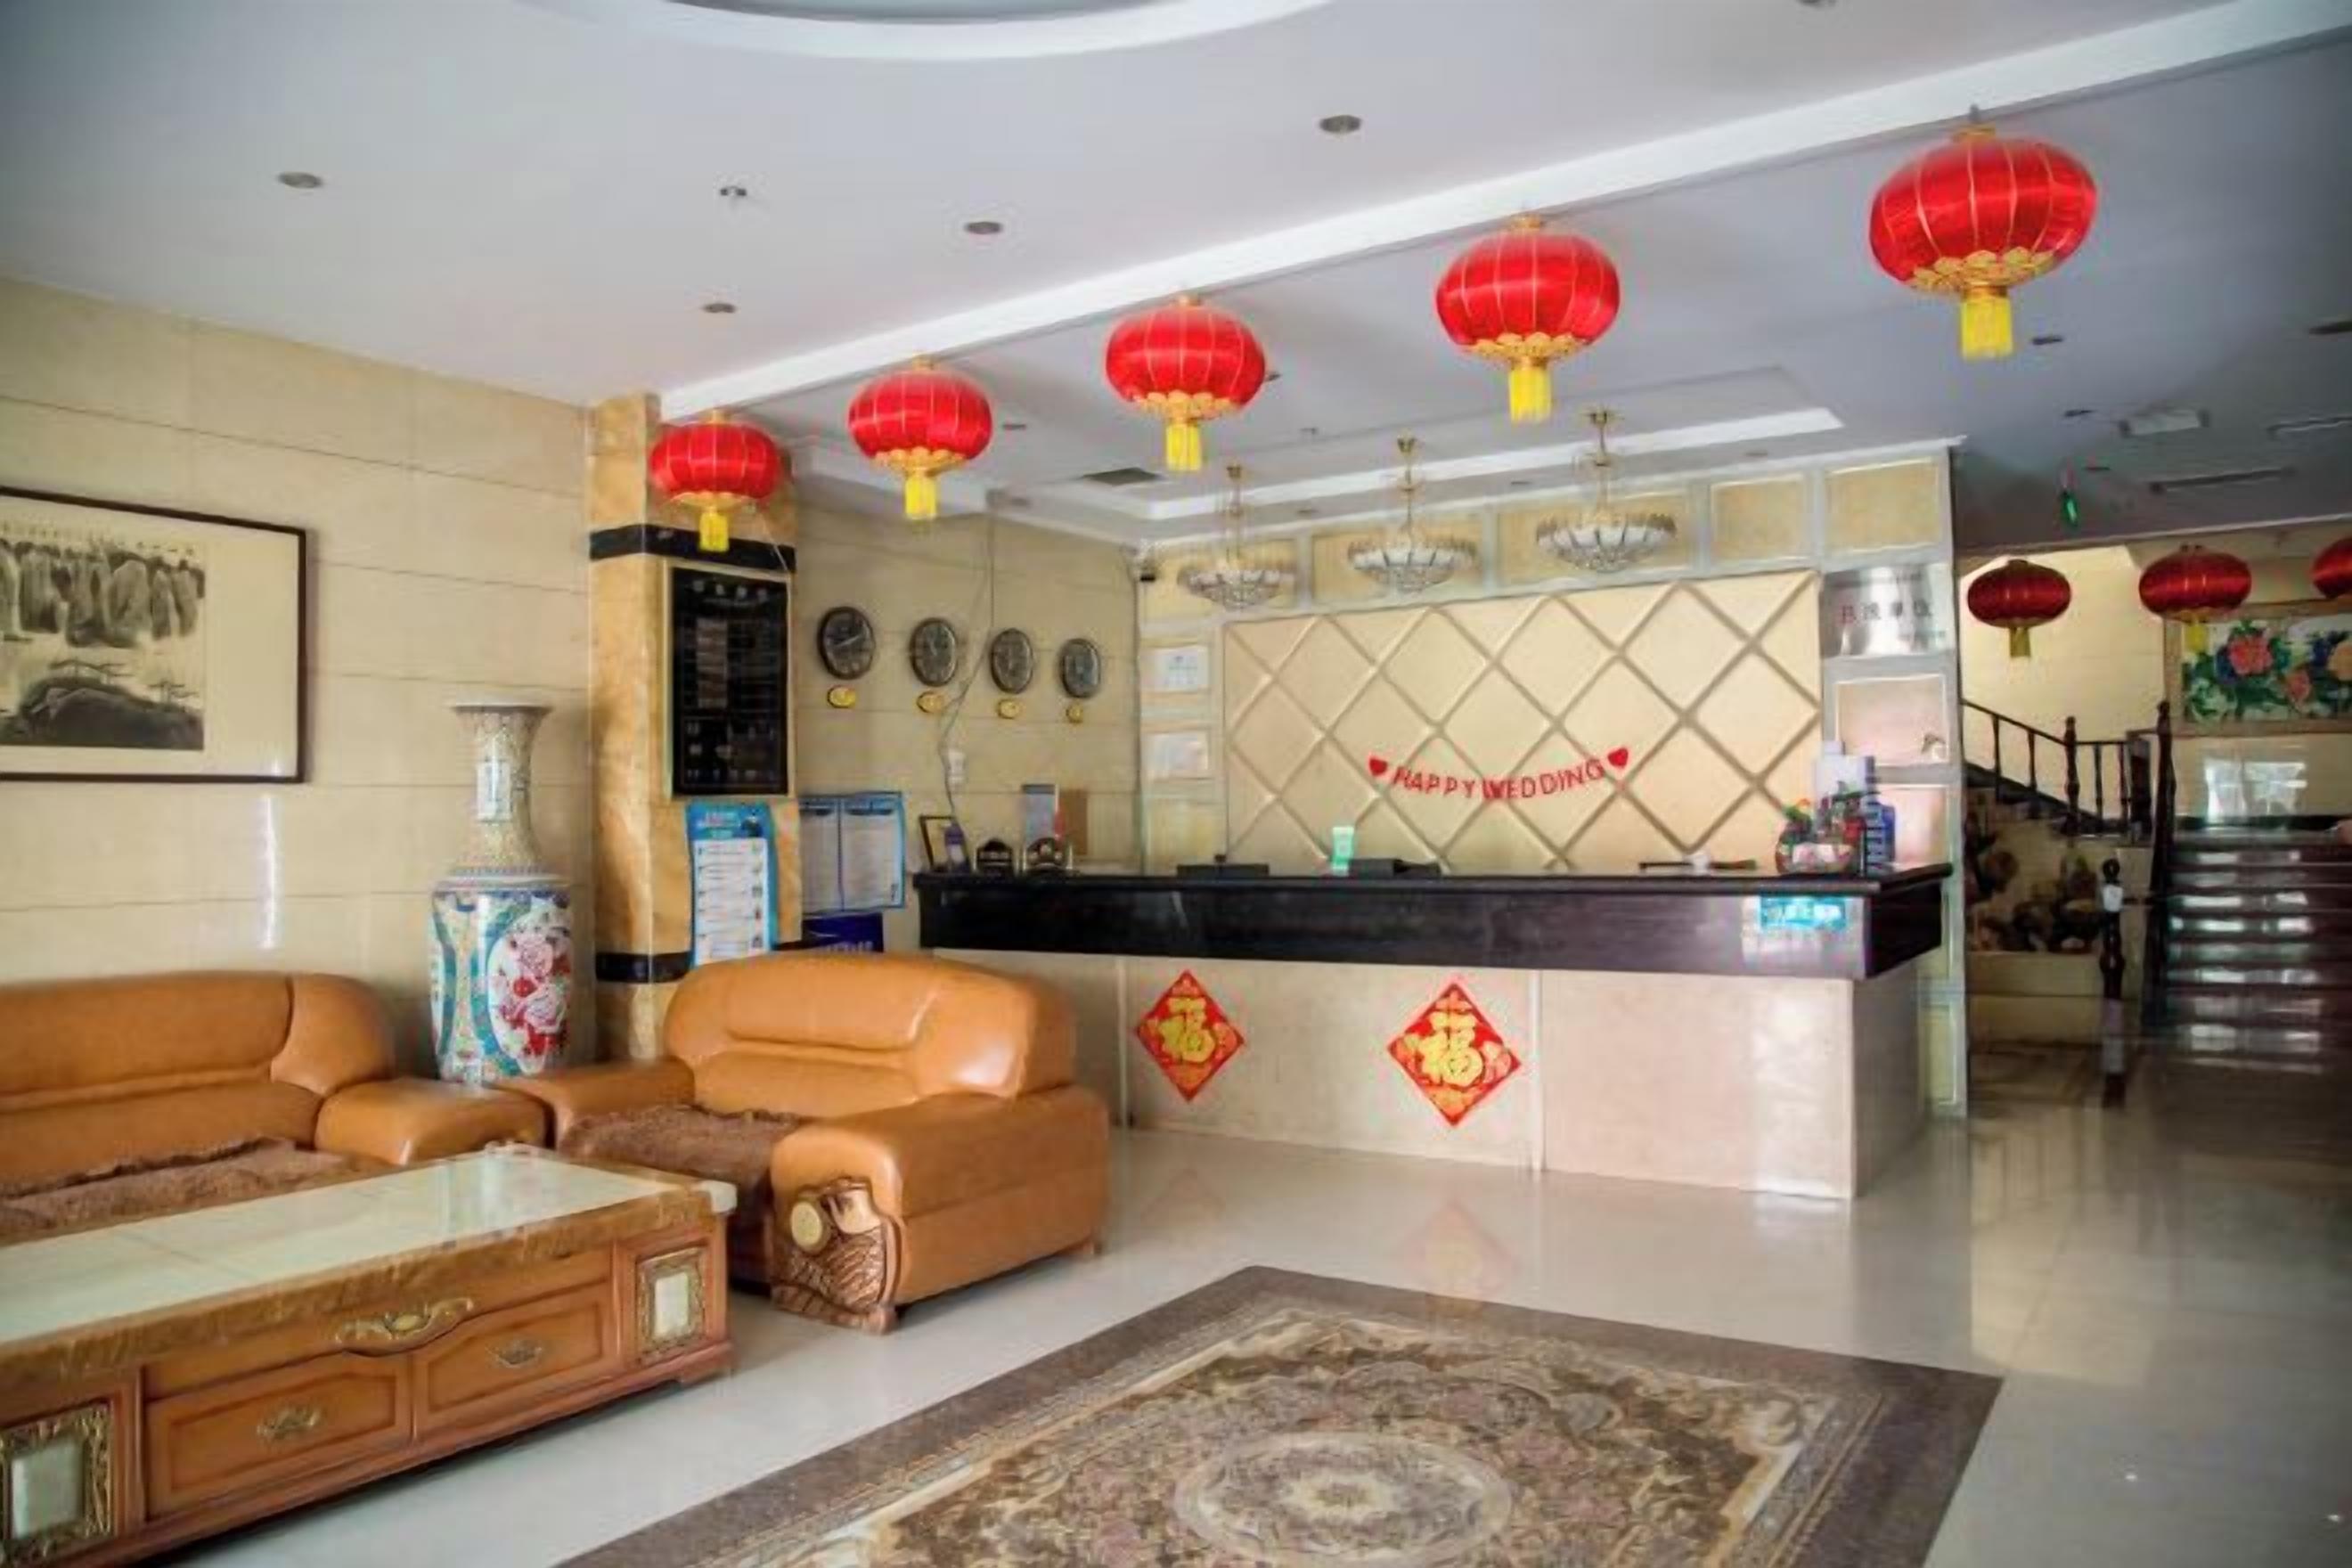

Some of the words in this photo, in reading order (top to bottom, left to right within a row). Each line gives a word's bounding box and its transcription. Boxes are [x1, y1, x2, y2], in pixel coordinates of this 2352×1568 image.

[1392, 765, 1475, 799] HAPPY
[1482, 757, 1605, 800] WEDDING
[1158, 996, 1216, 1063] 福
[1420, 1010, 1484, 1087] 福
